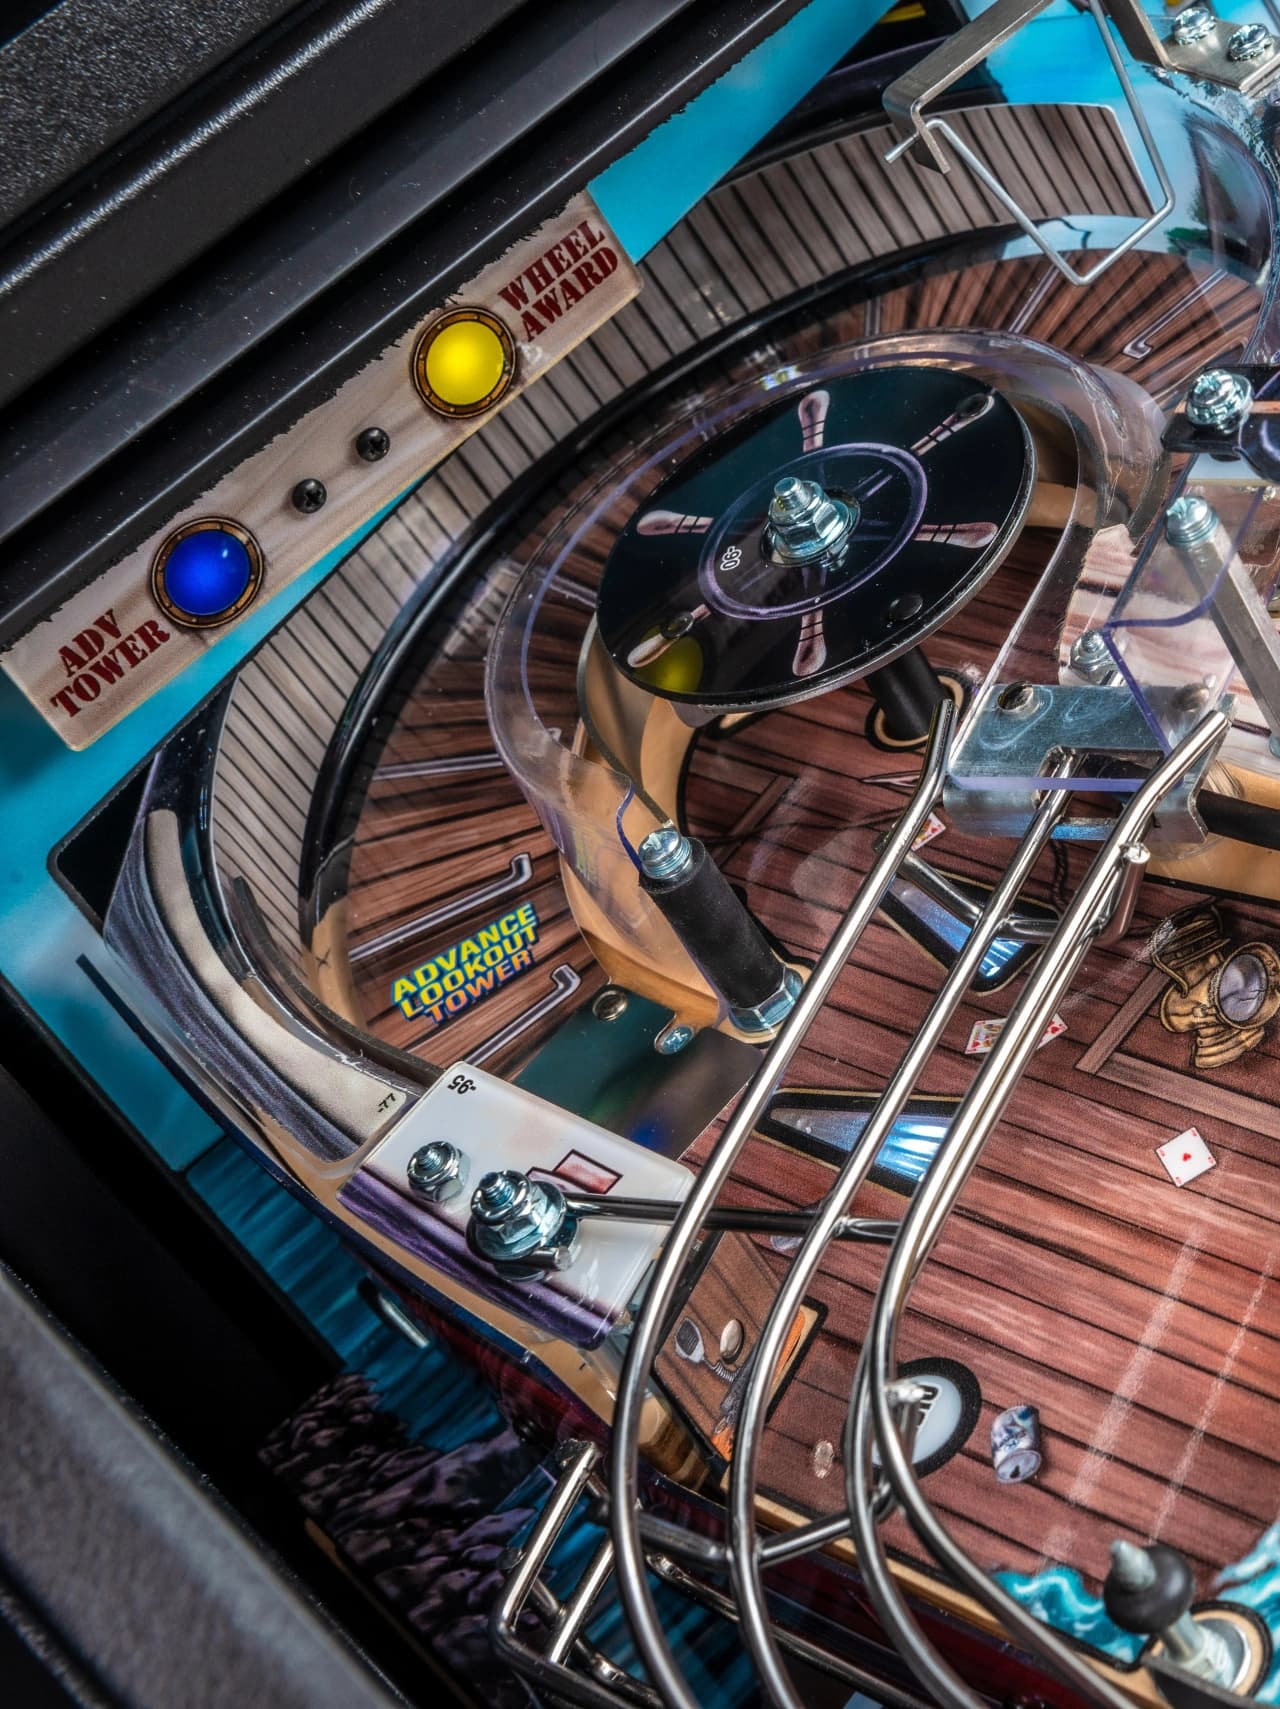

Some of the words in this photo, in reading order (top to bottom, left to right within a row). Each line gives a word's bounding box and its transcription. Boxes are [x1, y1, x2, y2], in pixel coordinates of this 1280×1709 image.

[498, 221, 606, 312] WHEEL
[520, 247, 618, 342] AWARD
[49, 620, 170, 718] TOWER
[58, 608, 122, 678] ADV
[393, 902, 537, 1003] ADVANCE
[400, 921, 537, 1019] LOOKOUT
[425, 949, 531, 1022] TOWER
[378, 1092, 397, 1113] -77
[447, 1074, 477, 1095] -95
